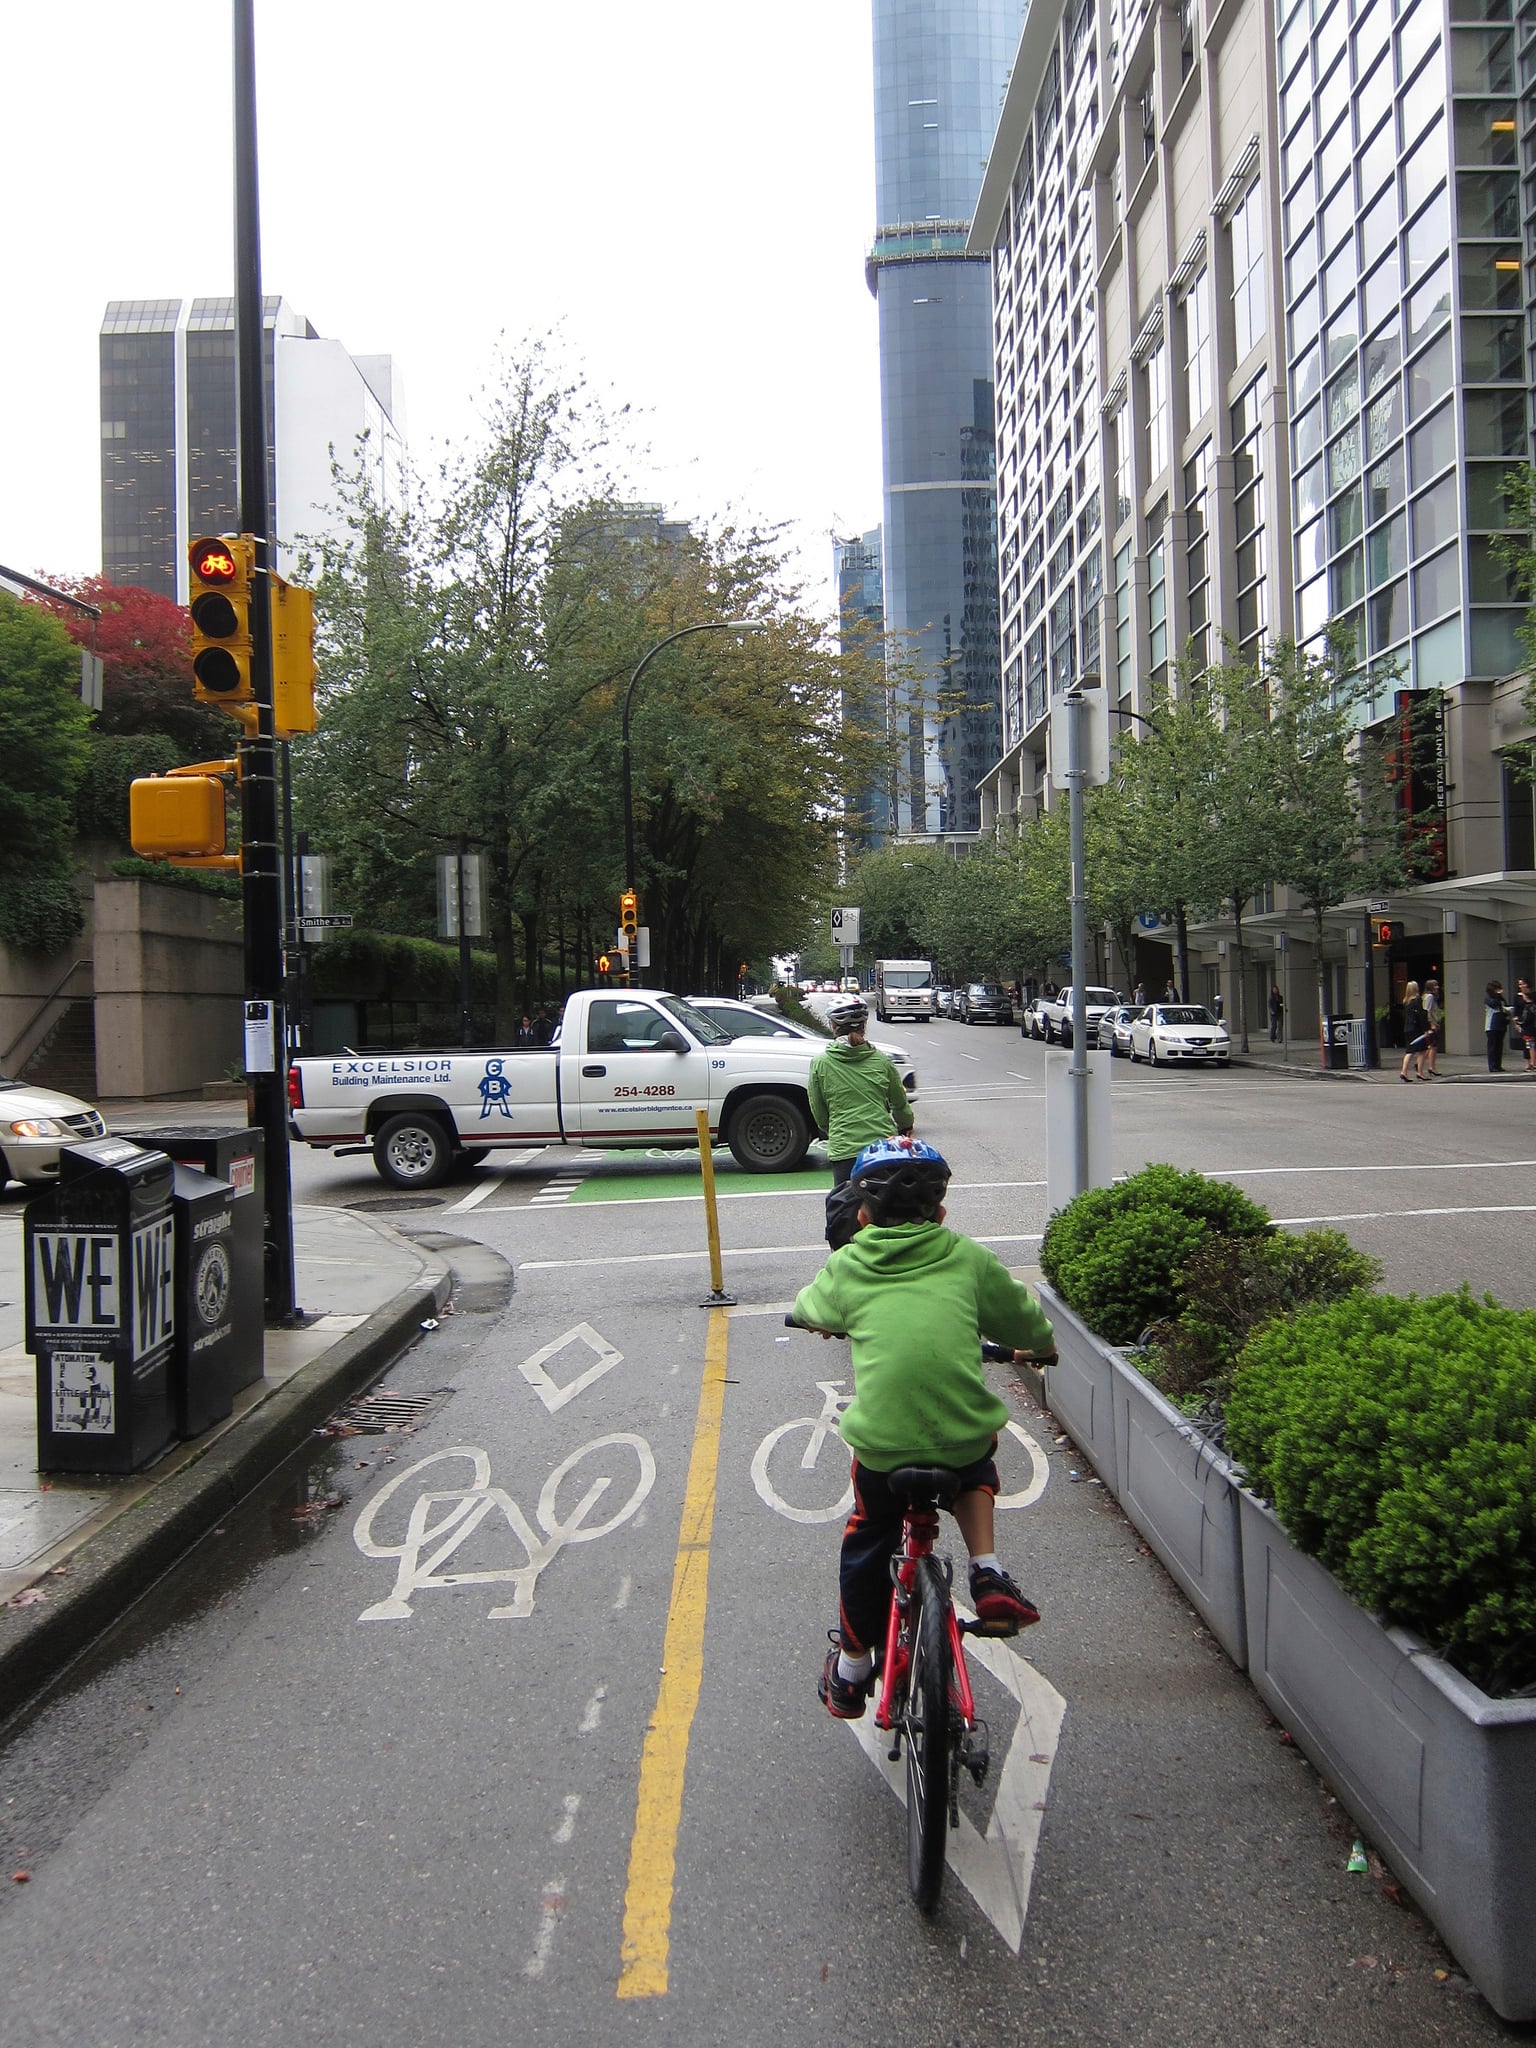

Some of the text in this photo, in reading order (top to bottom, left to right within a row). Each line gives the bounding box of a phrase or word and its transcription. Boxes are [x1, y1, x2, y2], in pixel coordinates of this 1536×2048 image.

[332, 1060, 452, 1073] EXCELSIOR
[711, 1060, 726, 1069] 99
[332, 1073, 452, 1087] Building Maintenance Ltd.
[614, 1085, 676, 1097] 254-4288
[38, 1236, 116, 1325] WE
[135, 1220, 173, 1353] WE
